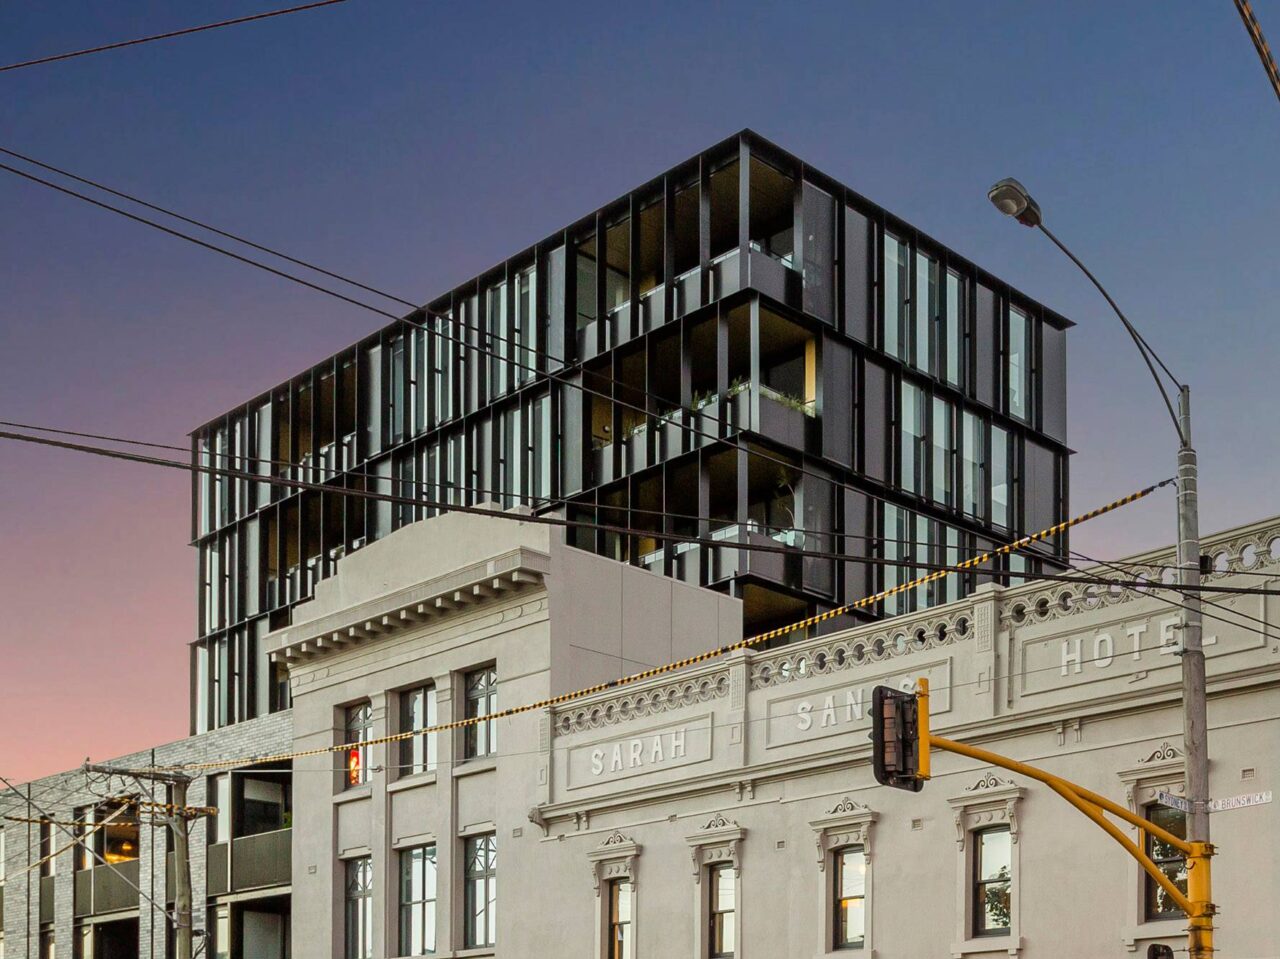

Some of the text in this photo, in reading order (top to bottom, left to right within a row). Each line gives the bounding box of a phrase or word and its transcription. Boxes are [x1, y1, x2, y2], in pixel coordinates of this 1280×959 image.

[591, 616, 1218, 776] SARAH SANS HOTE
[1164, 793, 1184, 810] SYDNEY
[1221, 795, 1264, 810] BRUNSWICK
